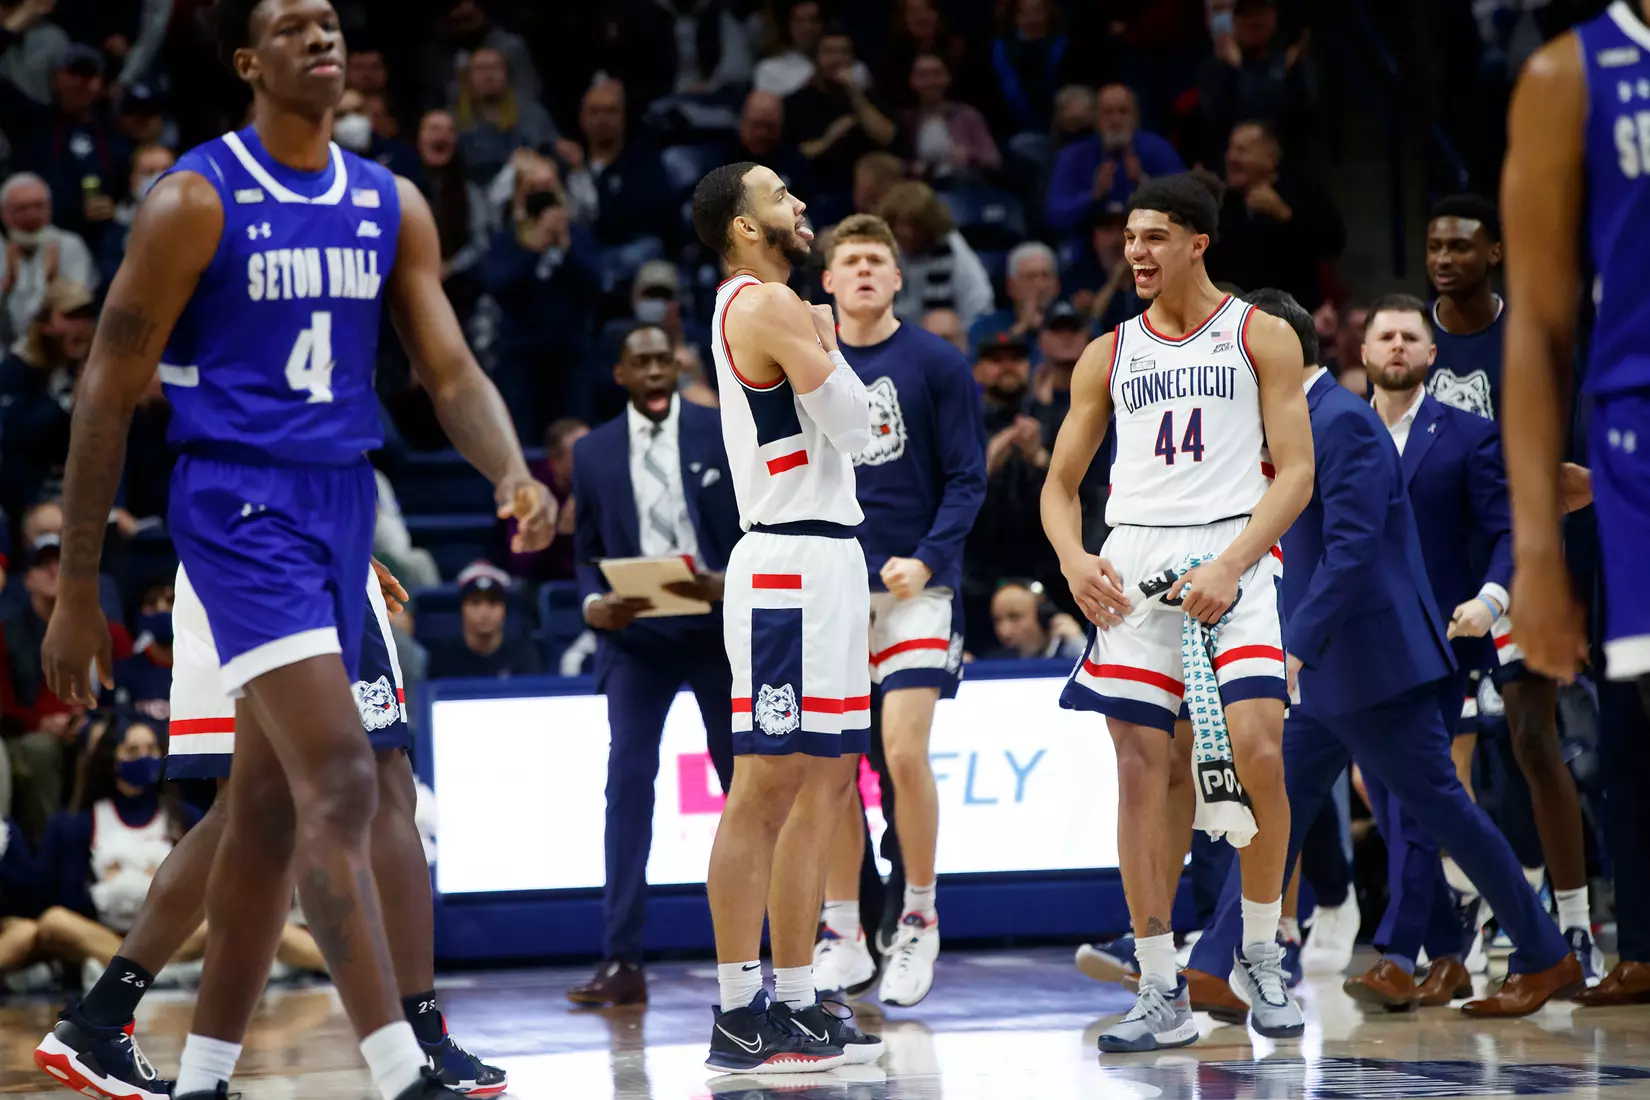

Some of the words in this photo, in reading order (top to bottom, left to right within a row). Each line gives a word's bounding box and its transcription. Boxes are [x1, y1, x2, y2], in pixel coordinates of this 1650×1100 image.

[247, 247, 323, 302] SETON
[325, 247, 382, 300] WALL
[284, 310, 334, 404] 4
[1121, 365, 1237, 415] CONNECTICUT
[1154, 407, 1205, 466] 44
